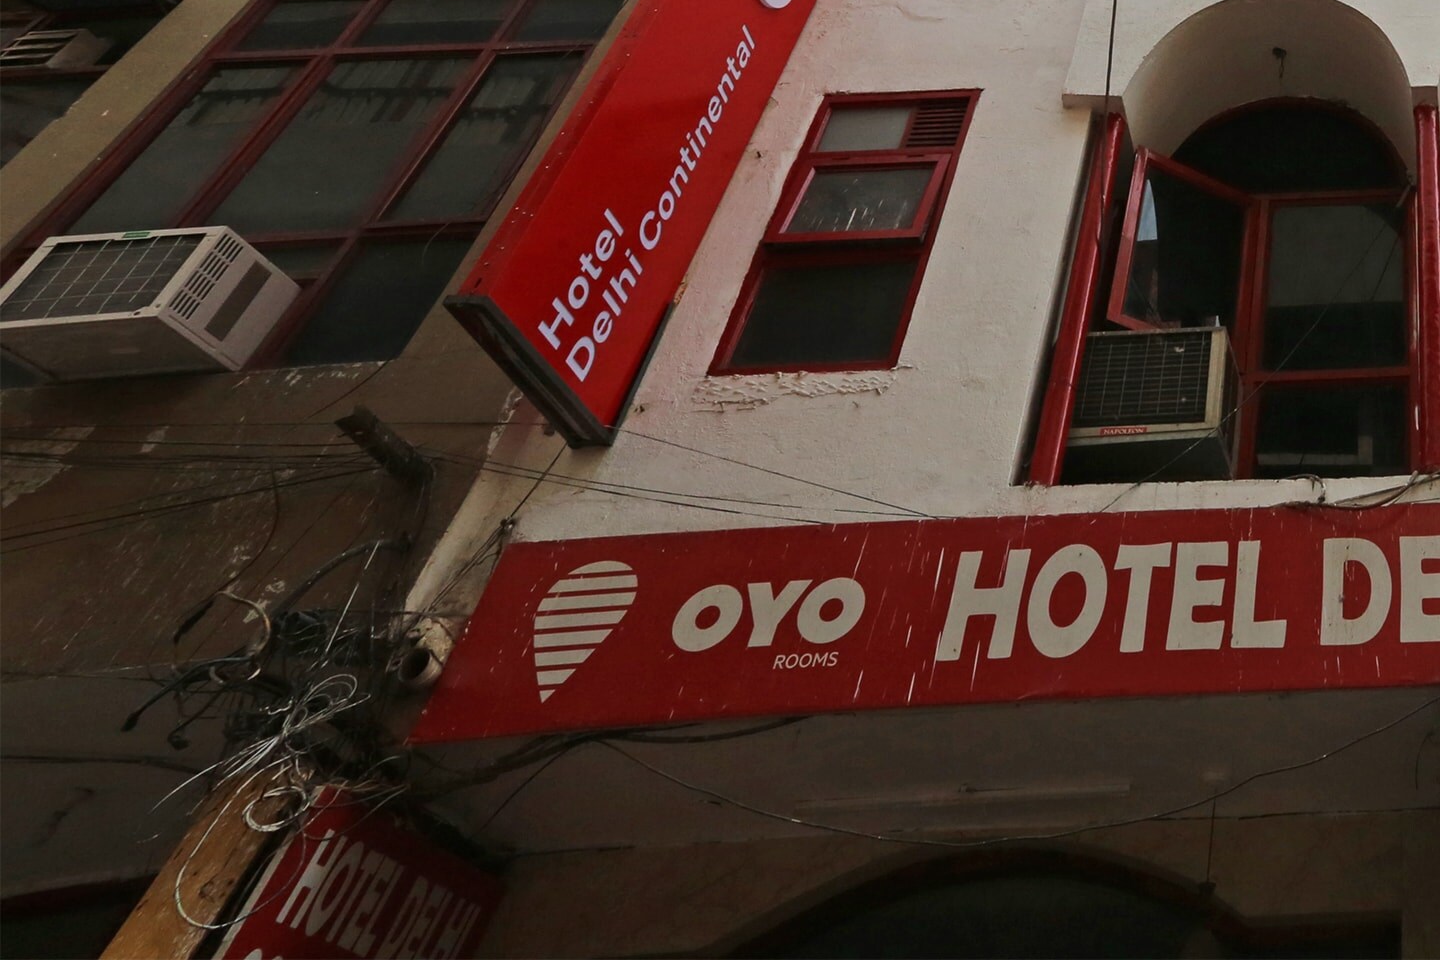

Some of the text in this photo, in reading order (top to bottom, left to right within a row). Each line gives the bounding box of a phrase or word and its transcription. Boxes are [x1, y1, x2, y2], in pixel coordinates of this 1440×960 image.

[566, 24, 757, 383] Delhi Continental
[538, 208, 625, 351] Hotel
[672, 577, 866, 653] OYO
[772, 651, 838, 671] ROOMS
[937, 540, 1287, 662] HOTEL
[275, 828, 405, 959] HOTEL
